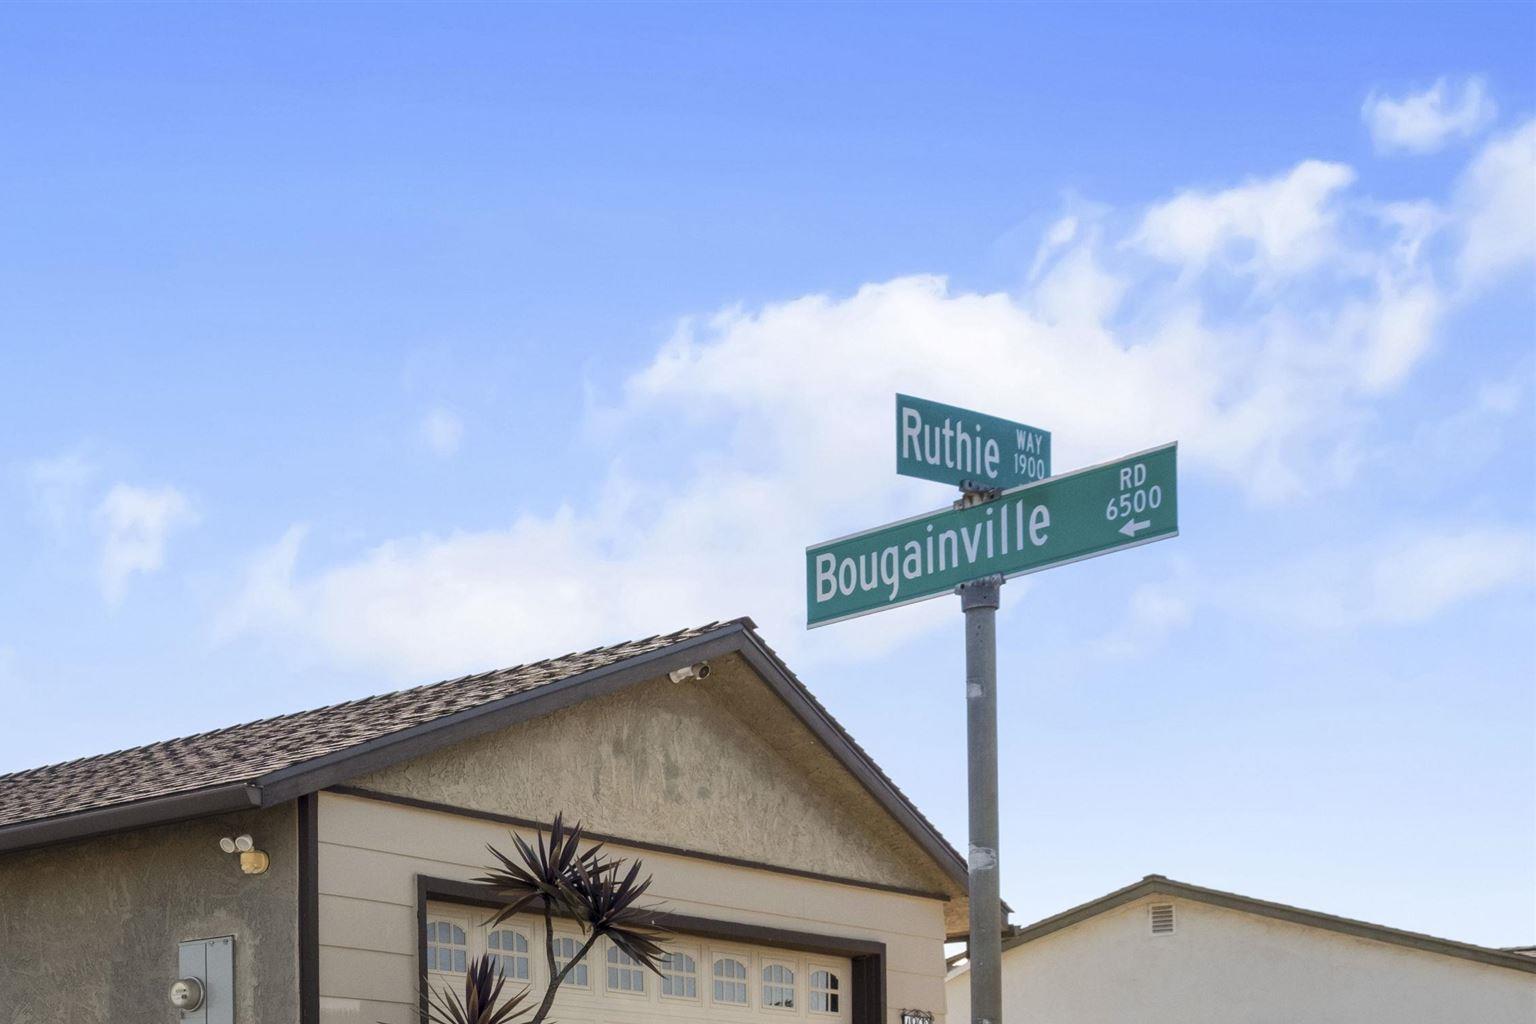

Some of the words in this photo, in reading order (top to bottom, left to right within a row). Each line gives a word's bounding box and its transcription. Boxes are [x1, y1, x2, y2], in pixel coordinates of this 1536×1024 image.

[901, 406, 1000, 479] Ruthie
[1016, 429, 1043, 455] WAY
[1014, 452, 1045, 480] 1900
[1120, 463, 1146, 491] RD
[1106, 485, 1162, 520] 6500
[816, 499, 1051, 602] Bougainville
